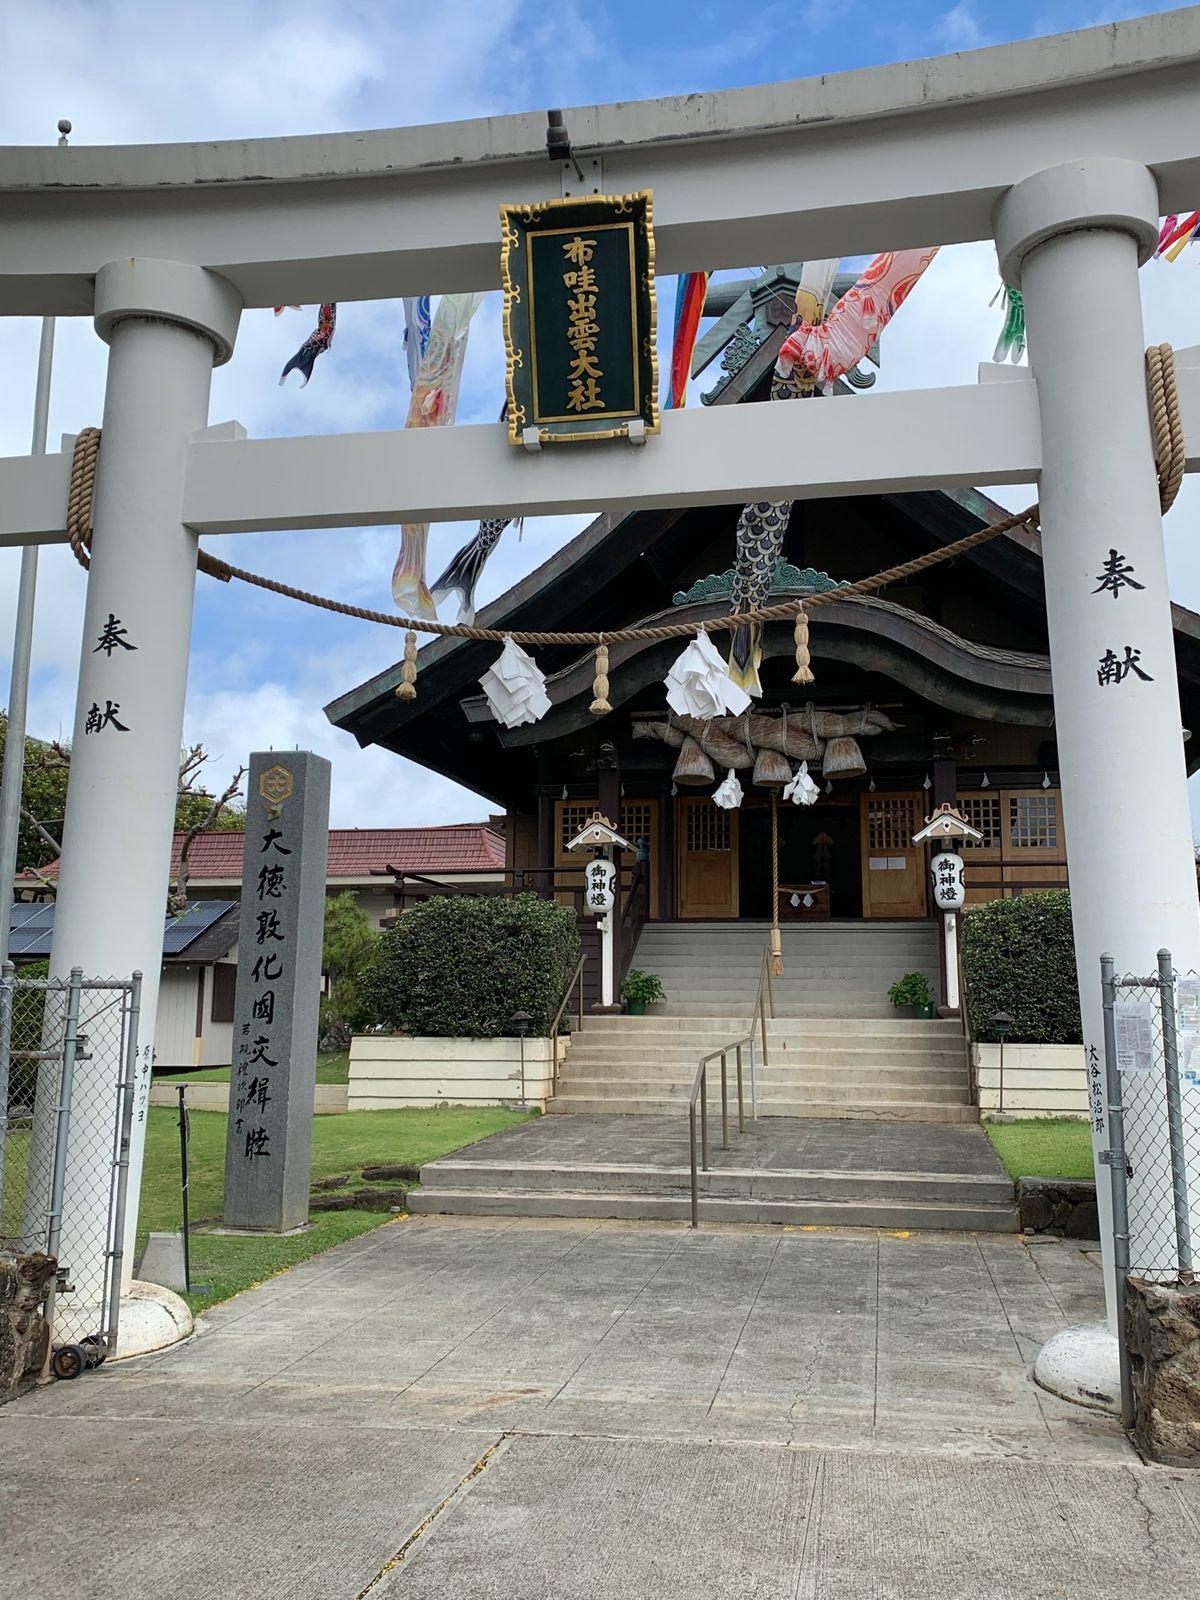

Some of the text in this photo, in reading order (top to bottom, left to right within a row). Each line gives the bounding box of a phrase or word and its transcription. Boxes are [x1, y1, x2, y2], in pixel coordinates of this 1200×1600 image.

[562, 237, 605, 411] 布哇出雲大社
[85, 613, 138, 736] 奉献
[1089, 548, 1155, 687] 奉献
[590, 864, 607, 906] 御神燈
[937, 858, 958, 901] 御神燈
